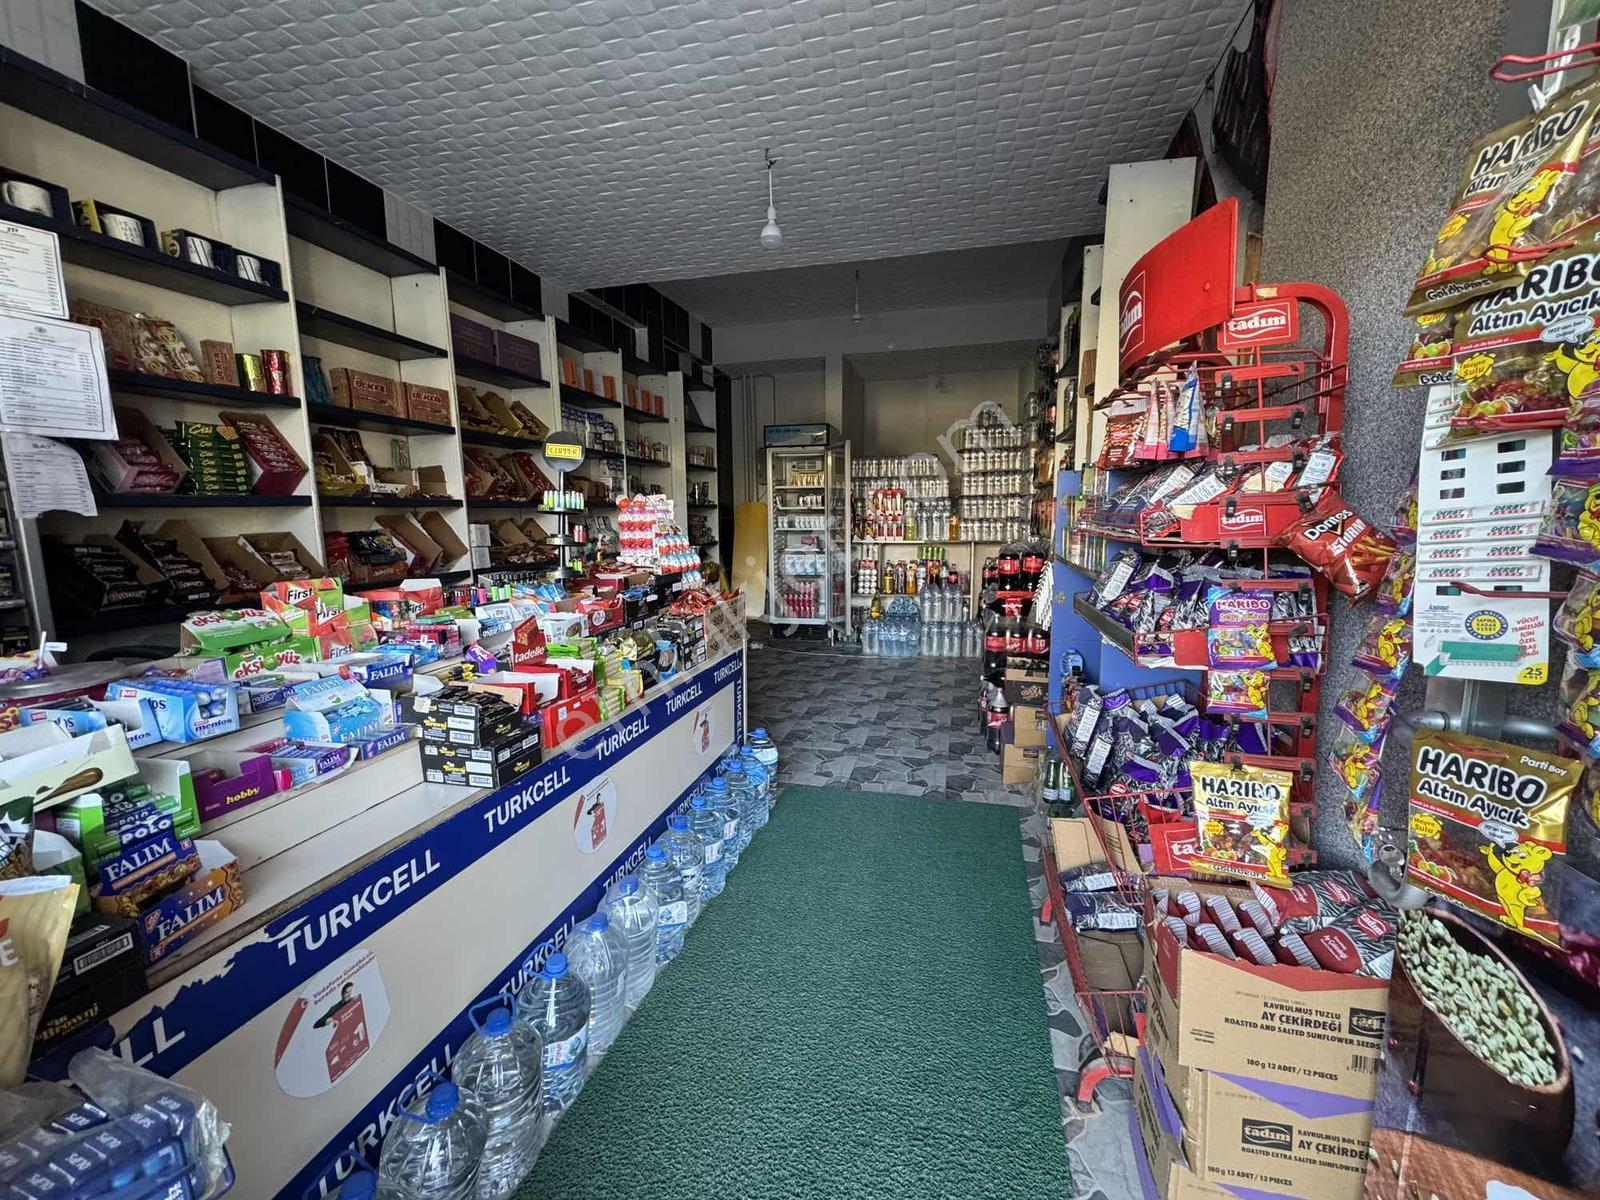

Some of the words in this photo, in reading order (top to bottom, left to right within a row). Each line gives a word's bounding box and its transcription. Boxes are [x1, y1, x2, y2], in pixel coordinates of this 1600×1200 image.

[1472, 101, 1587, 179] HARIBO
[1473, 257, 1600, 314] HARIB
[1227, 314, 1287, 332] tadım
[1470, 310, 1523, 335] Altın
[1303, 508, 1354, 542] Doritos
[287, 588, 313, 603] First
[1216, 599, 1270, 610] HARIBO
[192, 611, 222, 627] ekşi
[330, 645, 354, 658] First
[514, 646, 546, 663] tadelle
[235, 656, 264, 679] ekşi
[276, 651, 302, 669] yüz
[370, 664, 405, 681] FALIM
[713, 659, 743, 684] TURKCELL
[1525, 666, 1543, 676] 25
[665, 682, 703, 716] TURKCELL
[195, 718, 233, 733] mentos
[377, 731, 406, 750] FALIM
[595, 715, 650, 761] TURKCELL
[319, 754, 341, 769] FALIM
[1521, 756, 1549, 771] Parti
[1549, 765, 1568, 777] Boy
[1418, 748, 1545, 805] HARIBO
[225, 787, 260, 806] hobby
[1201, 777, 1281, 800] HARIBO
[483, 766, 571, 834] TURKCELL
[1206, 798, 1235, 810] Altın
[1418, 780, 1467, 806] Altın
[1469, 797, 1529, 828] Ayıcık
[121, 819, 172, 844] POLO
[104, 837, 174, 882] FALIM
[157, 886, 225, 941] FALIM
[277, 848, 441, 967] TURKCELL
[1263, 1001, 1313, 1018] KAVRULMUŞ
[1314, 1009, 1341, 1020] TUZLU
[1261, 1011, 1276, 1022] AY
[1279, 1013, 1342, 1033] ÇEKİRDEĞİ
[1224, 1017, 1258, 1029] ROASTED
[1259, 1023, 1276, 1033] AND
[1277, 1026, 1305, 1038] SALTED
[1306, 1031, 1354, 1046] SUNFLOWER
[1356, 1039, 1381, 1050] SEEDS
[1246, 1058, 1261, 1067] 180
[1267, 1061, 1277, 1070] 12
[1277, 1064, 1296, 1074] ADET
[1303, 1067, 1312, 1077] 12
[1313, 1069, 1338, 1081] PIECES
[1244, 1125, 1291, 1143] tadım
[1342, 1137, 1356, 1145] BOL
[1241, 1147, 1271, 1157] ROASTED
[1271, 1151, 1293, 1161] EXTRA
[1294, 1156, 1318, 1166] SALTED
[1318, 1159, 1360, 1173] SUNFLOWER
[1298, 1140, 1313, 1150] AY
[1316, 1142, 1371, 1161] ÇEKİRDE
[1207, 1165, 1221, 1173] 180
[1227, 1168, 1236, 1177] 12
[1236, 1170, 1255, 1181] ADET
[1259, 1174, 1269, 1183] 12
[1269, 1175, 1293, 1187] PIECES
